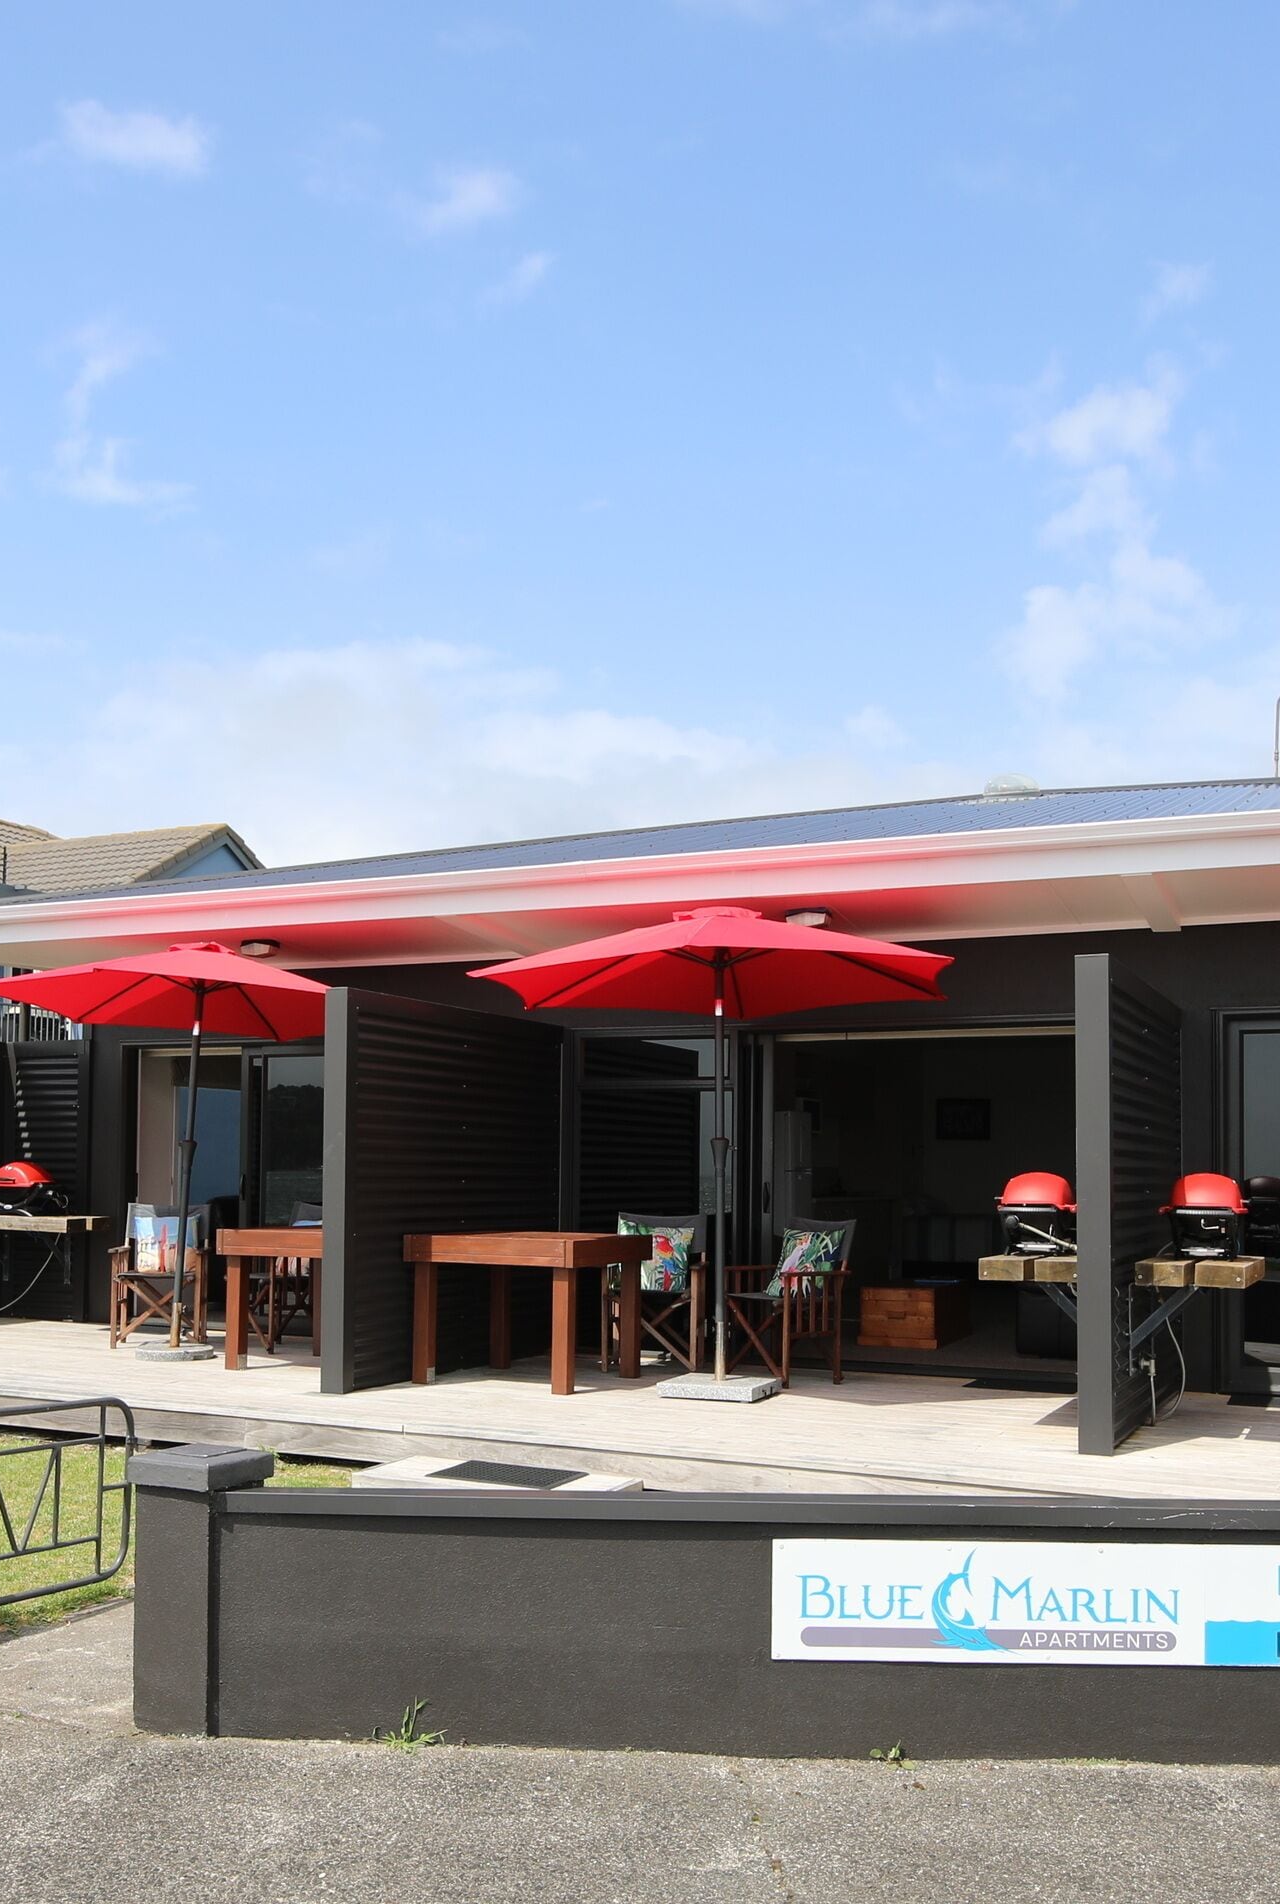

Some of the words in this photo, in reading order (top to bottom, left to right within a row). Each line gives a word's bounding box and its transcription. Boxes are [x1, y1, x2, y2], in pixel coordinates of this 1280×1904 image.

[795, 1574, 924, 1620] BLUE
[990, 1576, 1181, 1626] MARLIN
[1020, 1632, 1169, 1649] APARTMENTS
